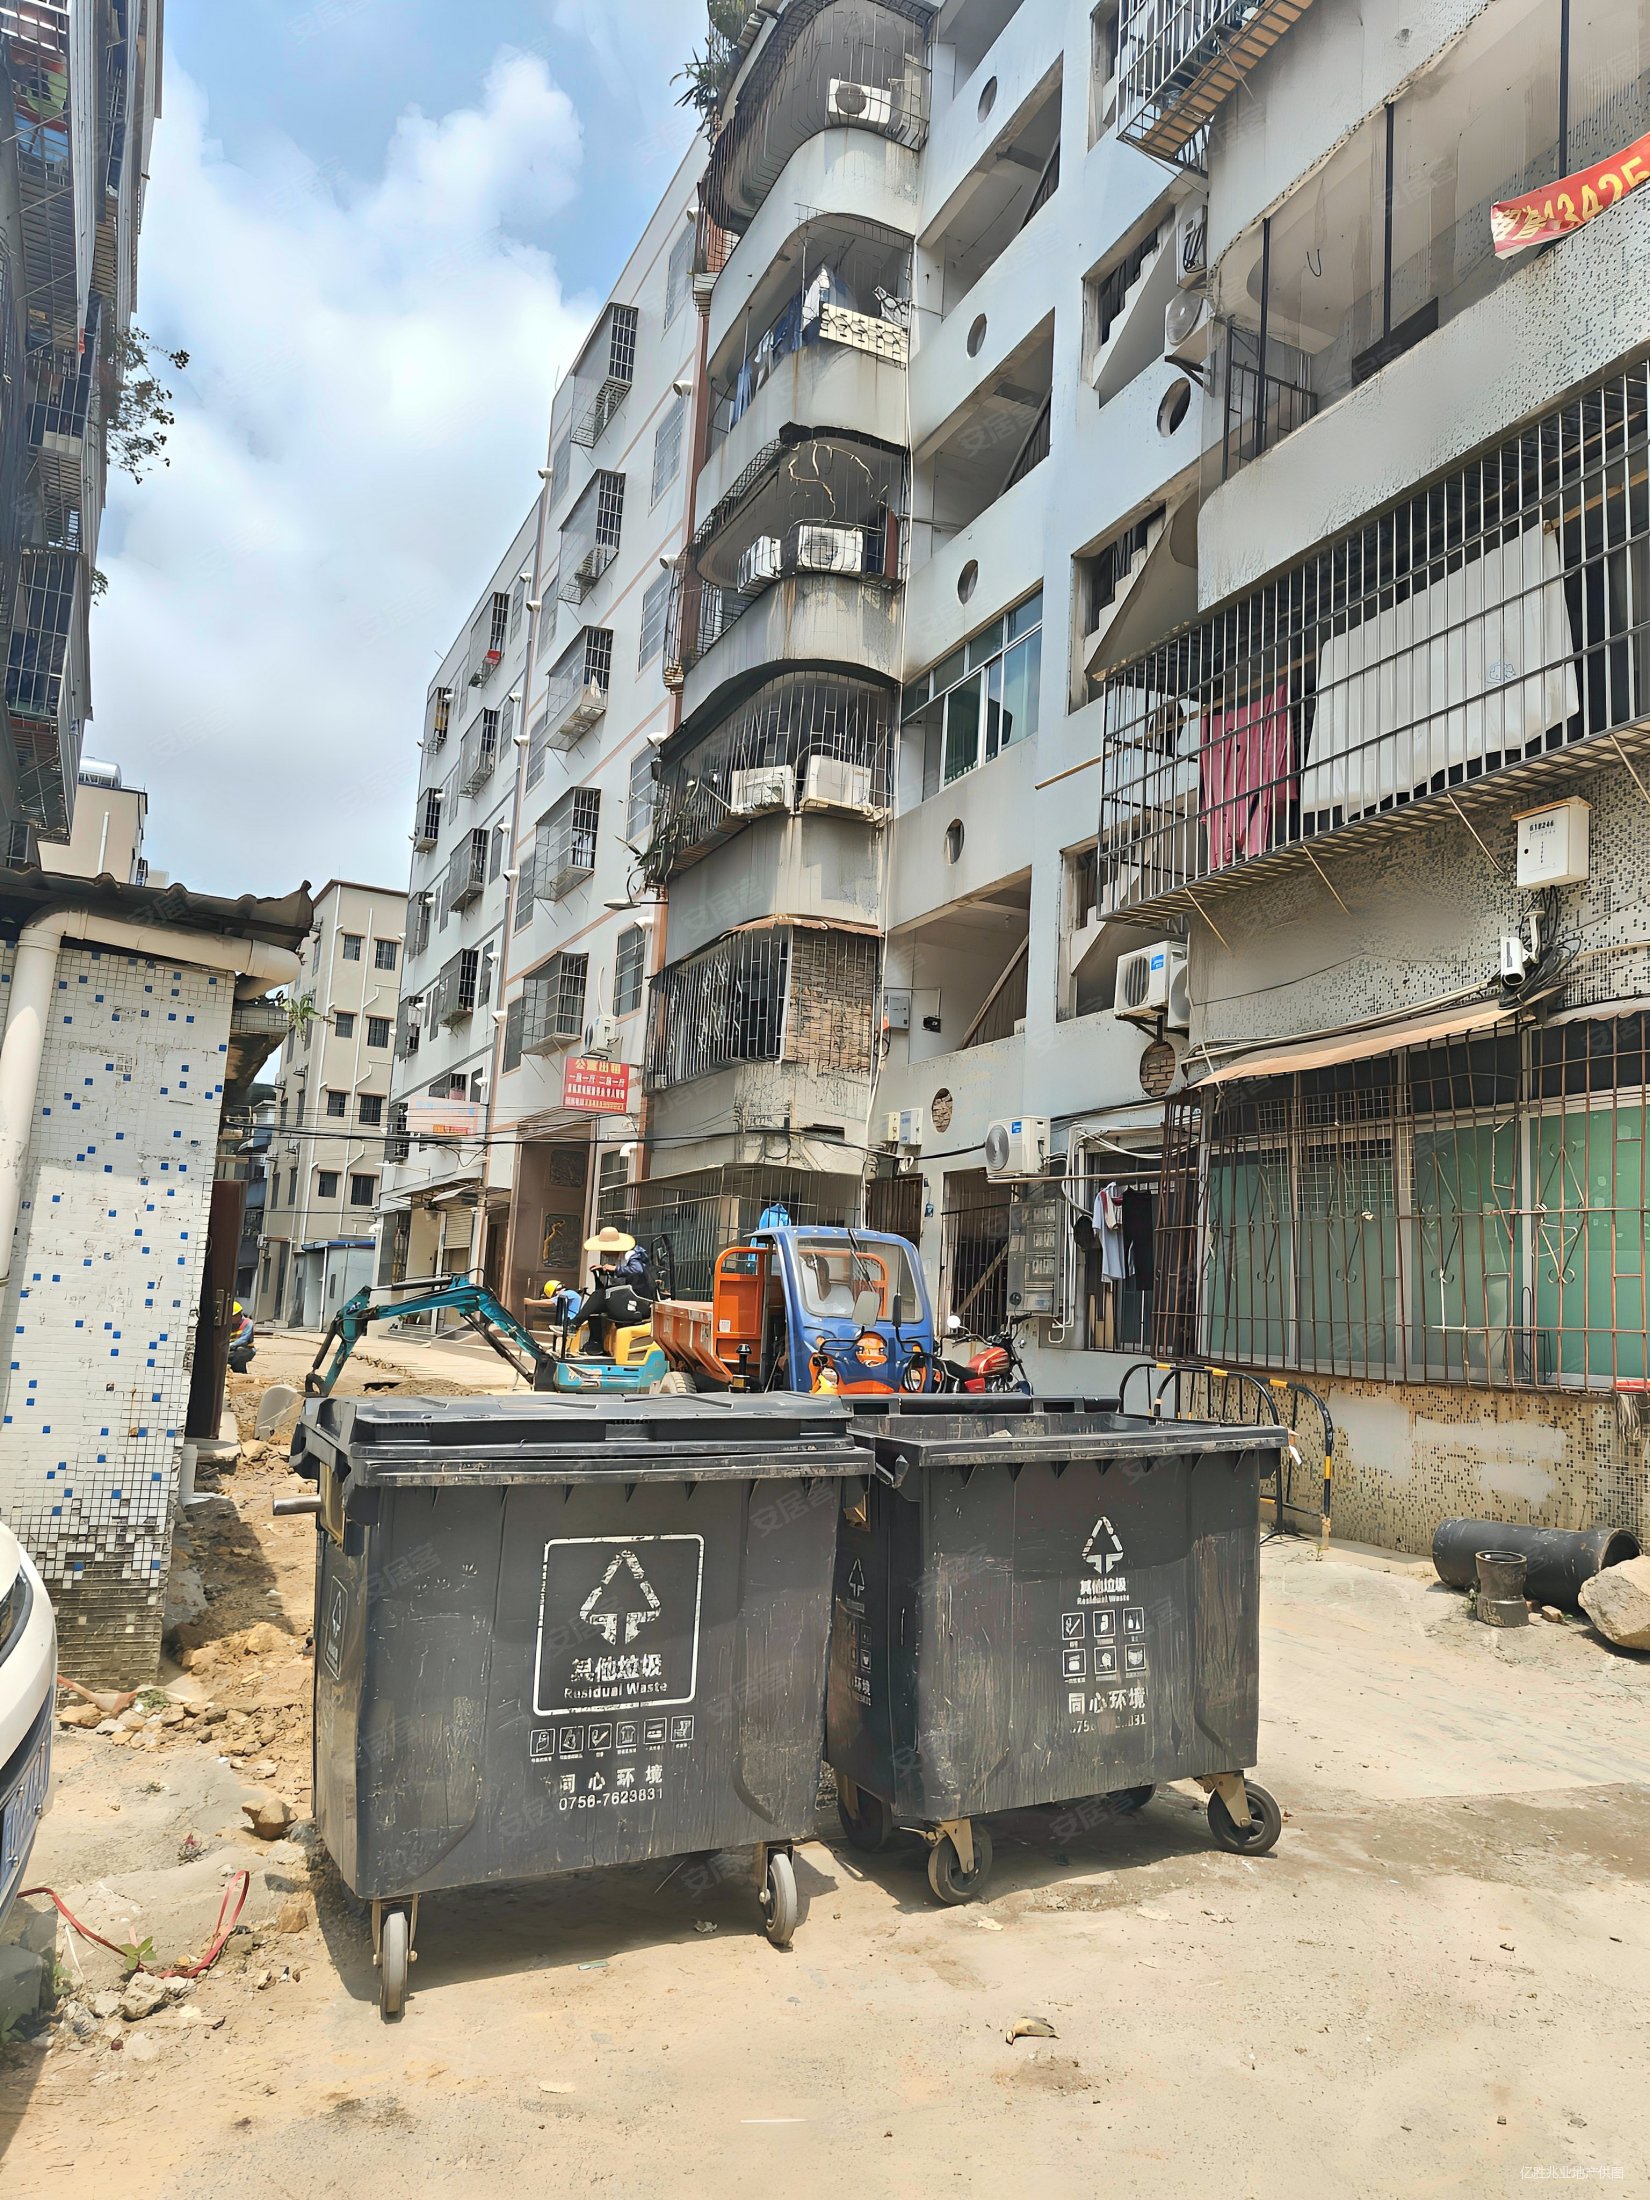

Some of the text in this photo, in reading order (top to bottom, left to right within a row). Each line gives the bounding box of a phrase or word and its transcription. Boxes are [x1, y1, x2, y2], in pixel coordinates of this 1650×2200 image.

[1080, 1577, 1126, 1595] 其他垃圾
[570, 1653, 663, 1683] 其他垃圾
[564, 1681, 668, 1700] Residual Waste
[1068, 1687, 1146, 1715] 同心环境
[560, 1763, 663, 1794] 同心环境
